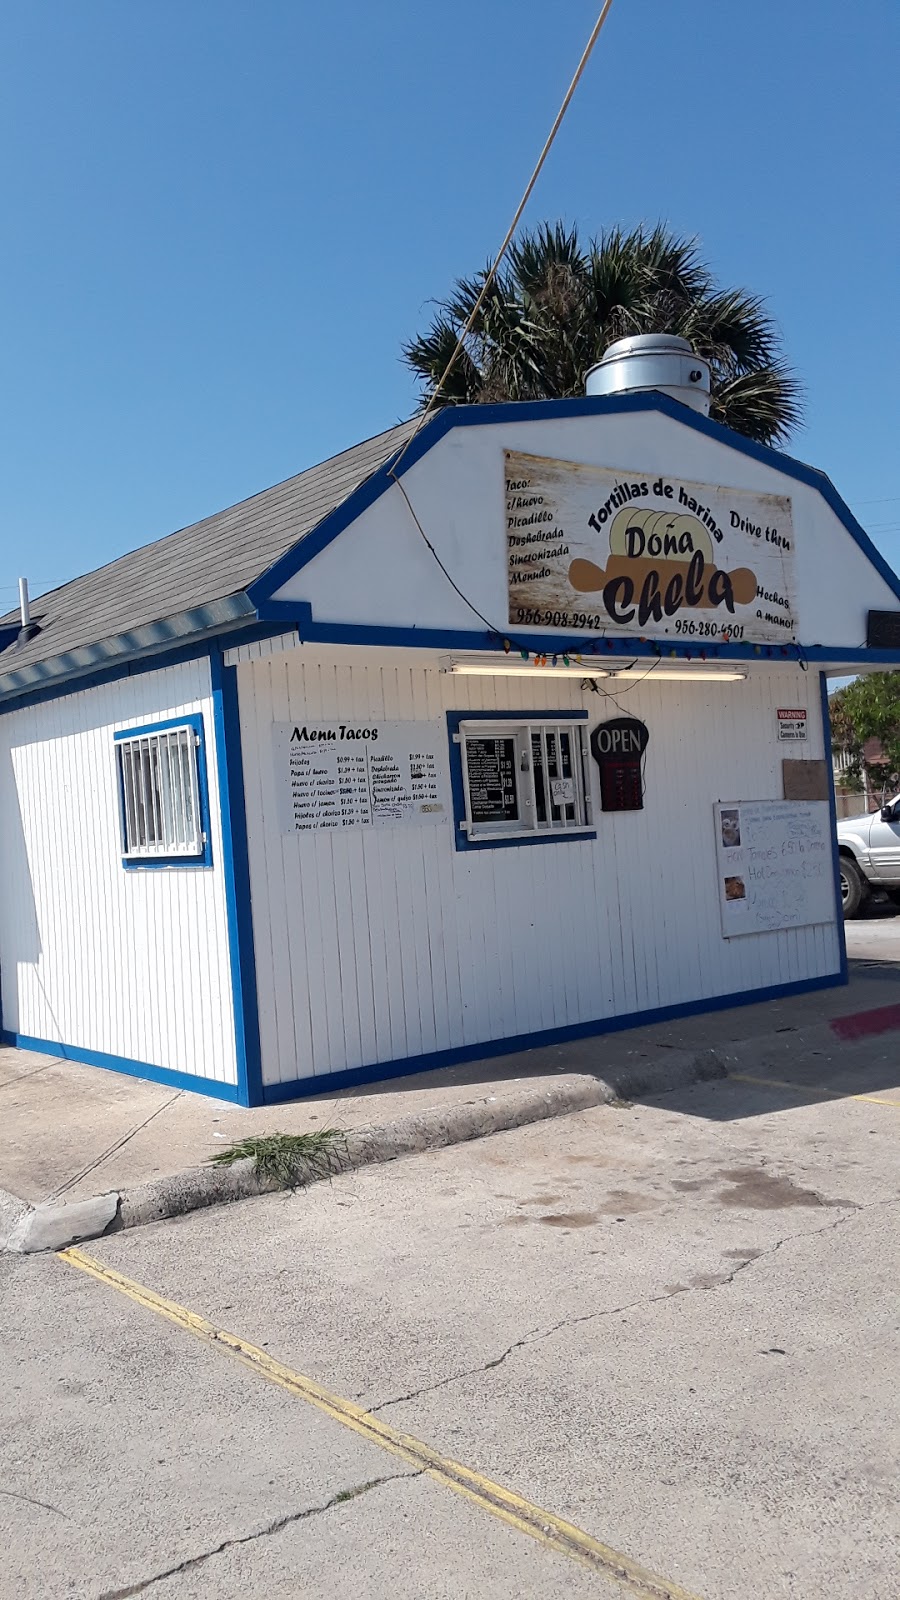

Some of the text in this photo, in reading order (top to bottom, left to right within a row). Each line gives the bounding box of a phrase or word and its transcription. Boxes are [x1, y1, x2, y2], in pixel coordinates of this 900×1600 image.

[508, 511, 553, 528] Picadillo
[588, 479, 724, 543] Tortillas de harina
[509, 528, 564, 547] Deshebrada
[625, 523, 694, 558] Doña
[730, 510, 790, 550] Drive thru
[510, 546, 569, 566] Sincronizada
[510, 567, 551, 585] Menudo
[603, 550, 735, 626] Chela
[757, 586, 790, 609] Hechas
[756, 610, 794, 628] a mano!
[290, 726, 378, 742] Menu Tacos
[597, 729, 641, 753] OPEN
